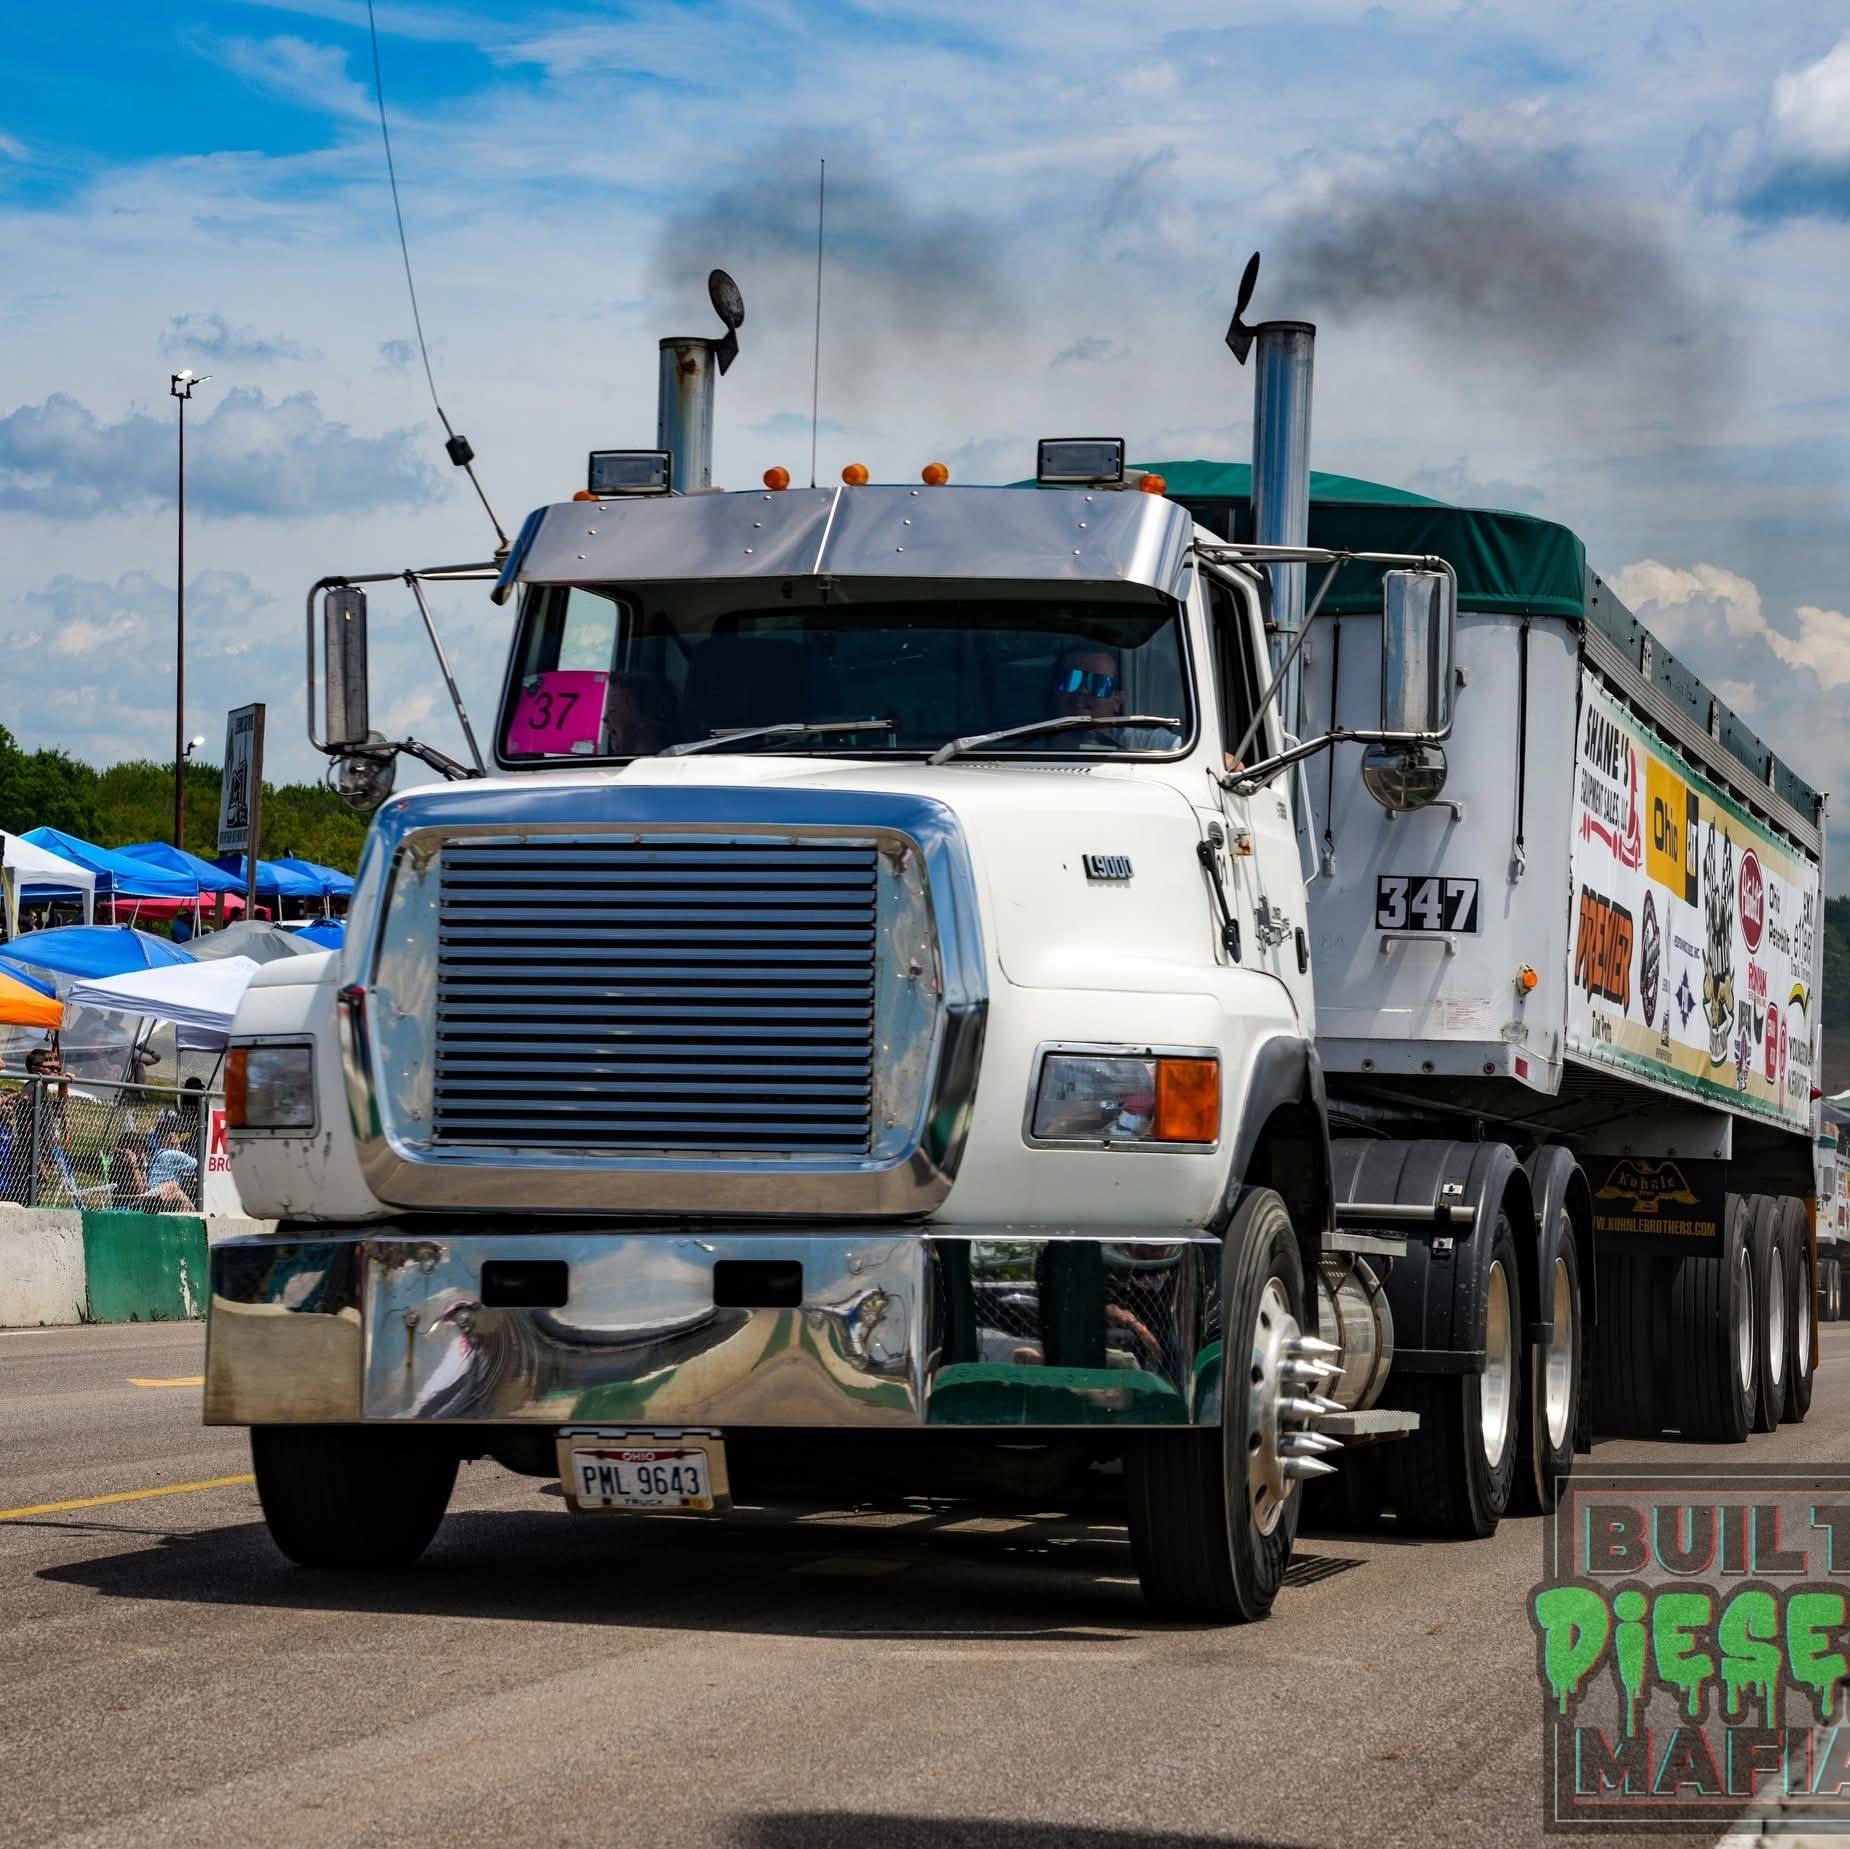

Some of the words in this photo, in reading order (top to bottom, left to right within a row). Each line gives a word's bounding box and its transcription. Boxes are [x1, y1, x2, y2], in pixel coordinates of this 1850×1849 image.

[528, 692, 581, 731] 37
[1584, 703, 1629, 787] SHANE'S
[1653, 796, 1678, 863] Ohio
[1378, 877, 1478, 930] 347
[1574, 883, 1633, 1019] PREMIER
[208, 1157, 232, 1172] BRO
[622, 1452, 656, 1461] OHIO
[583, 1466, 631, 1494] PML
[637, 1466, 700, 1495] 9643
